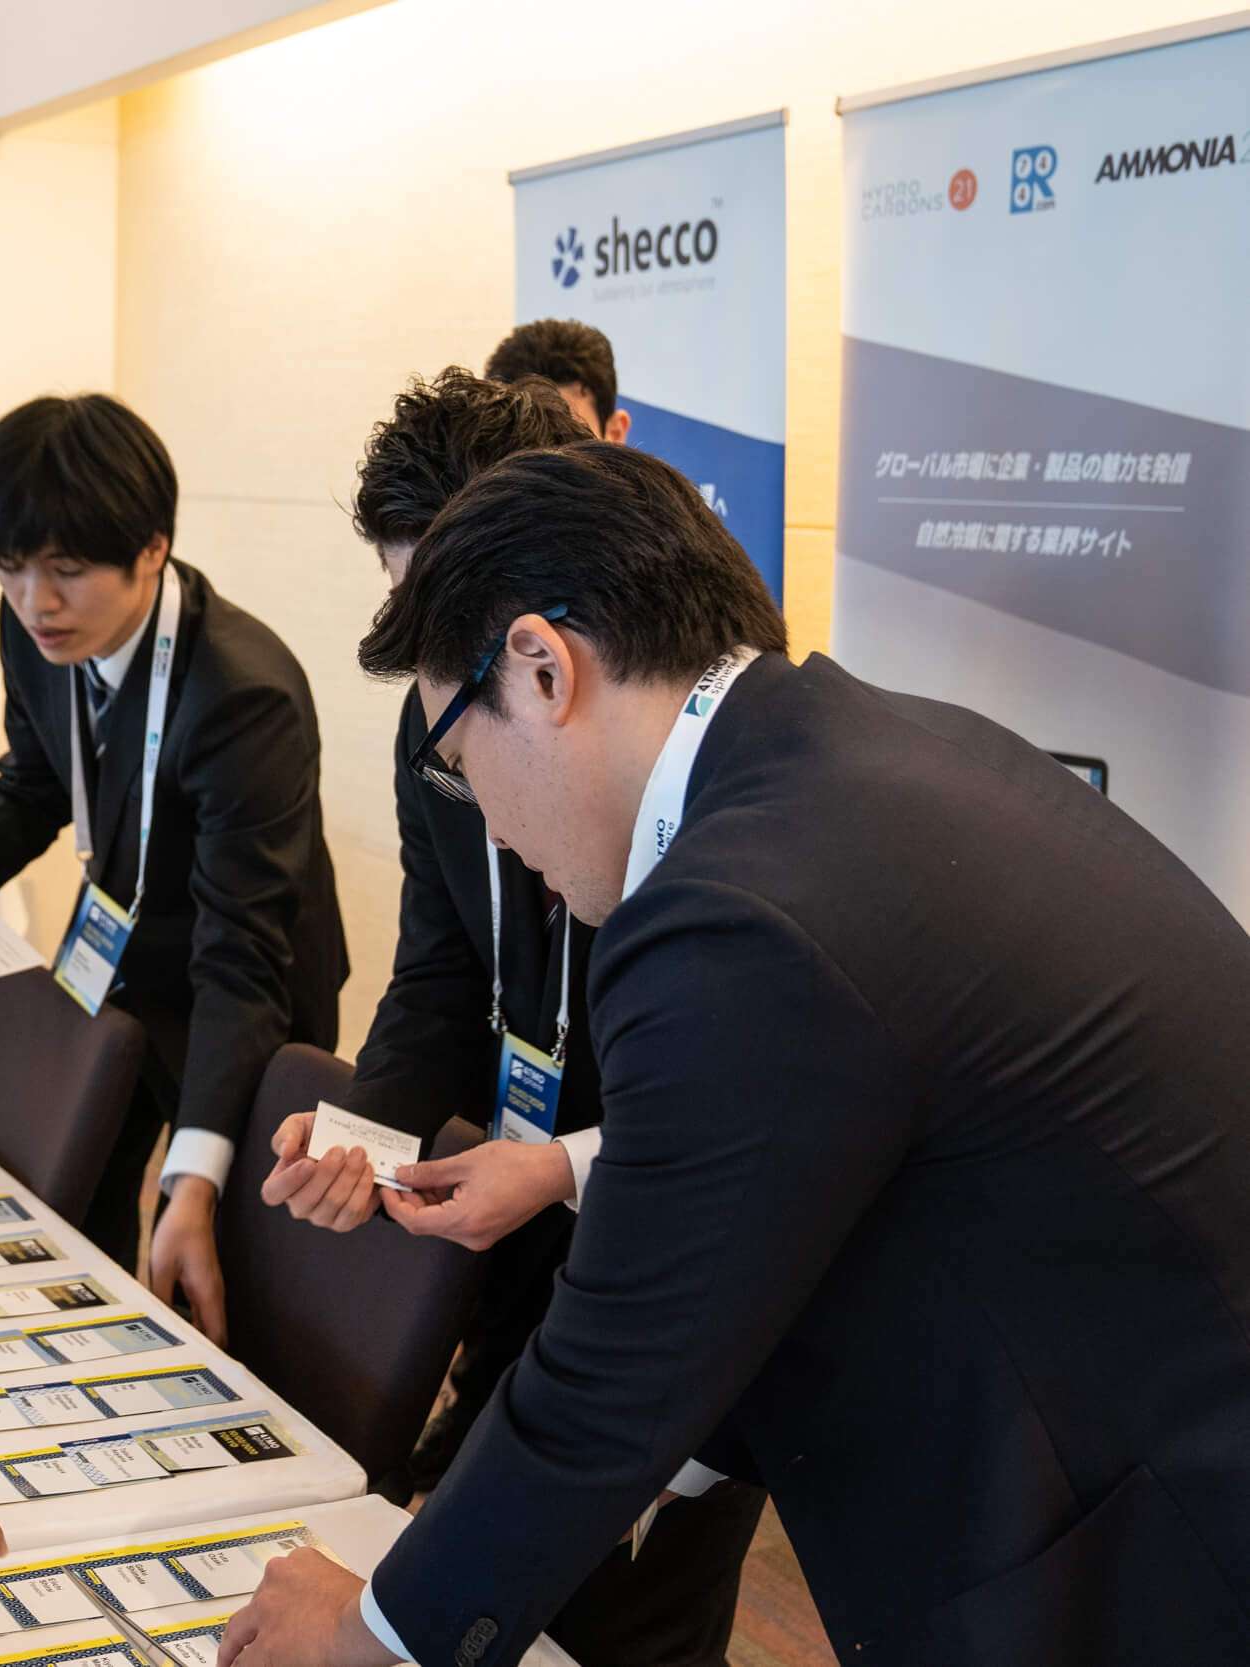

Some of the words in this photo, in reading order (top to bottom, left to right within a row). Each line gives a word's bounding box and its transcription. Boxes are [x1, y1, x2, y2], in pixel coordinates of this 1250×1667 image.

[861, 178, 921, 203] HYDRO
[861, 192, 944, 221] CARBONS
[595, 214, 718, 278] shecco
[697, 658, 729, 692] ATMO
[710, 660, 740, 695] sphere
[656, 818, 667, 857] TMO
